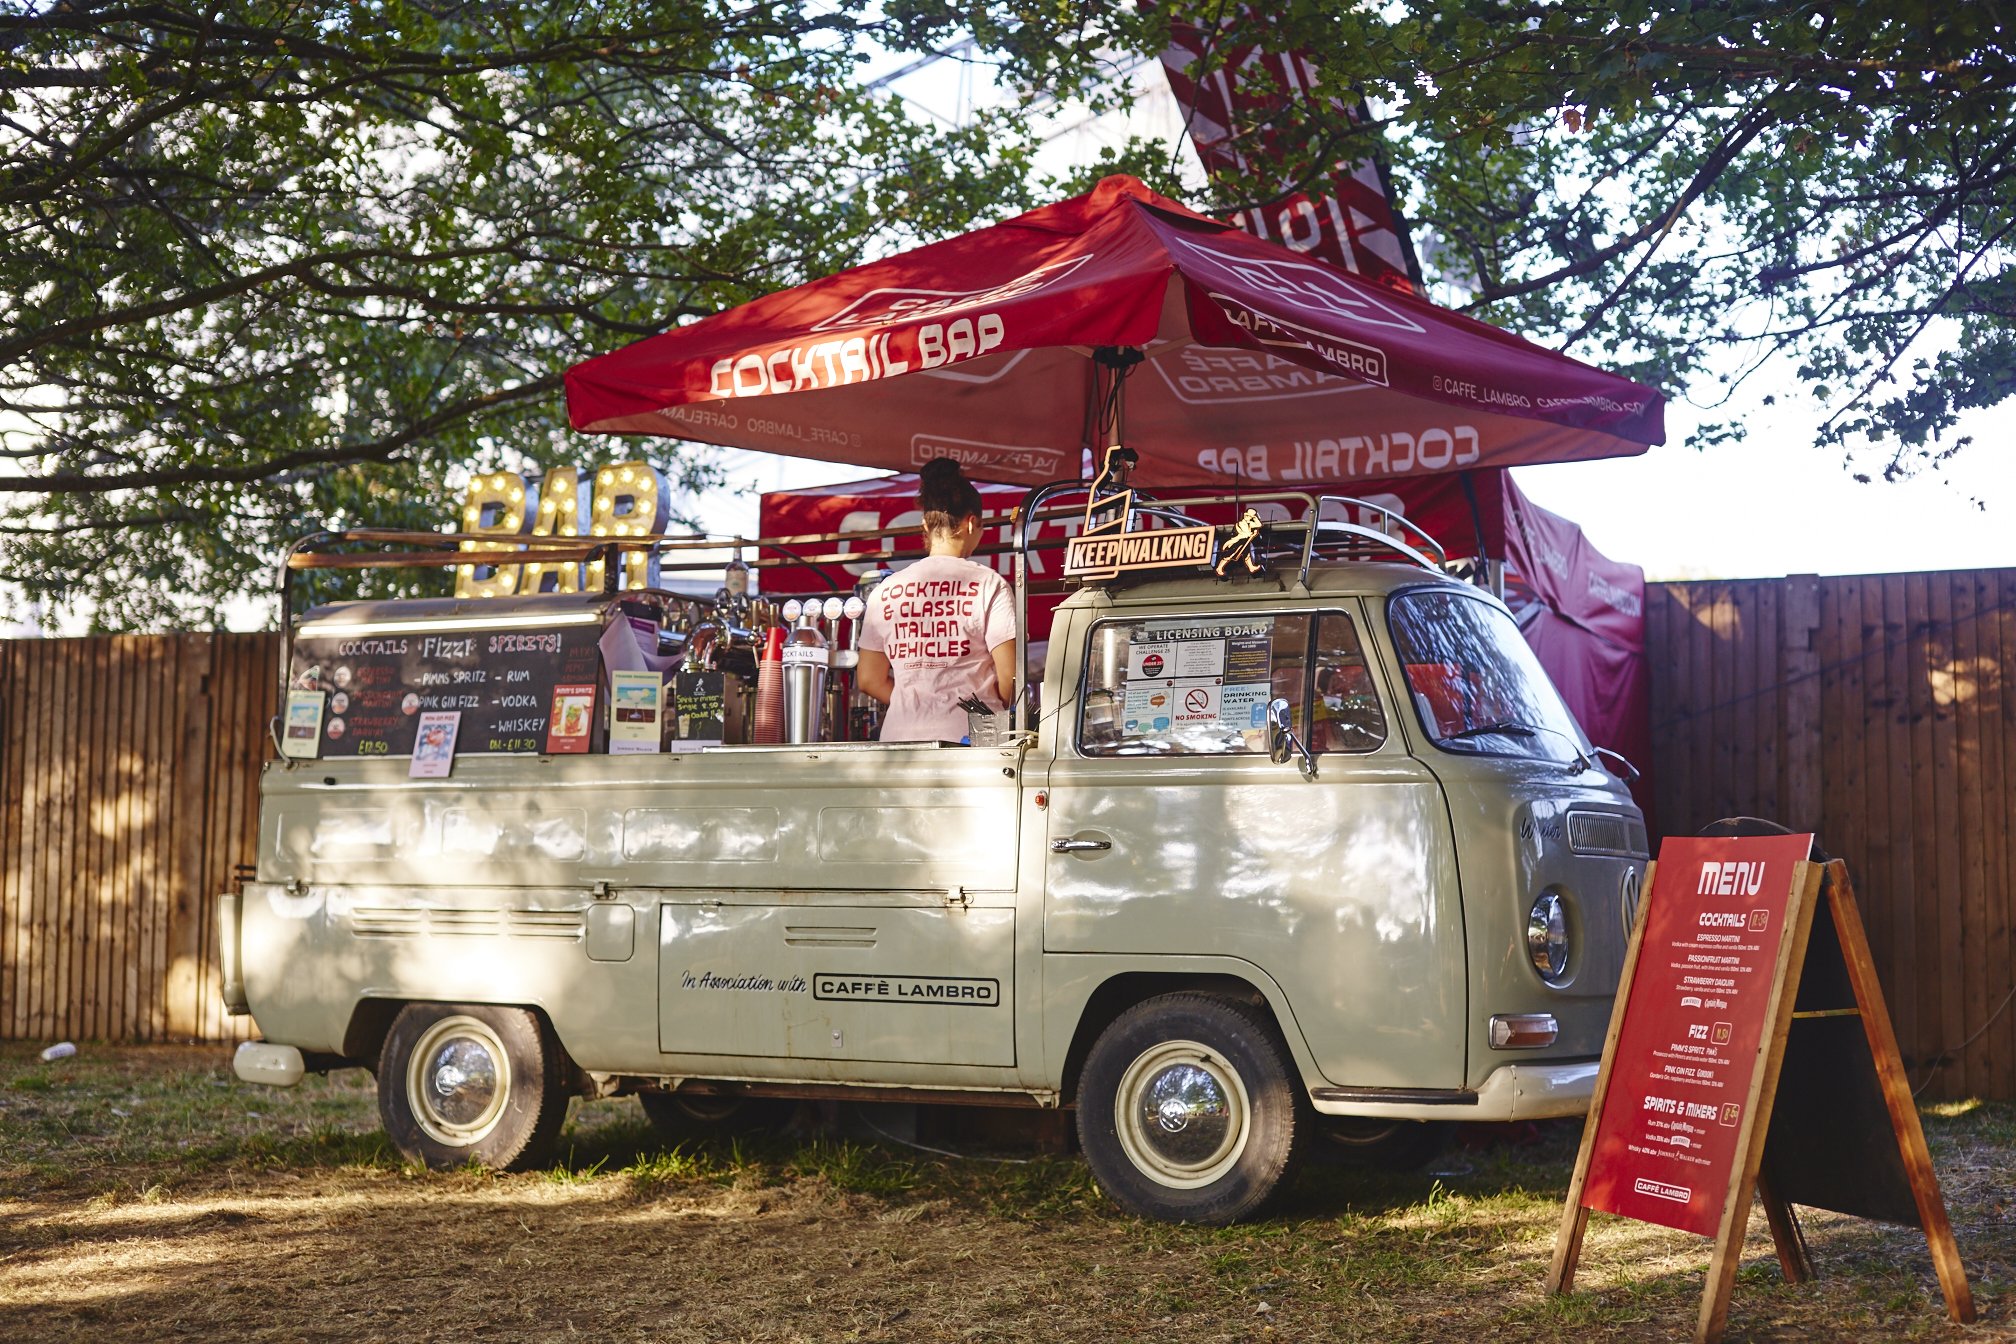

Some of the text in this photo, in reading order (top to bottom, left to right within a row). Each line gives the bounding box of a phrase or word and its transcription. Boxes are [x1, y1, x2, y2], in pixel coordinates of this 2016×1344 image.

[709, 313, 1005, 398] COCKTAIL BAR
[1444, 378, 1532, 409] CAFFE_LAMBRO
[454, 460, 662, 599] BAR
[1072, 533, 1208, 568] KEEP WALKING
[881, 580, 980, 602] COCKTAILS
[883, 600, 973, 621] & CLASSIC
[895, 620, 959, 639] ITALIAN
[1156, 627, 1220, 641] LICENSING
[1224, 625, 1268, 637] BOARD
[339, 639, 408, 656] COCKTAILS
[888, 639, 971, 660] VEHICLES
[453, 671, 486, 684] SPRITZ
[507, 670, 530, 682] RUM
[419, 694, 479, 708] PINK GIN FIZZ
[501, 695, 538, 708] VODKA
[498, 718, 546, 732] WHISKEY
[1697, 861, 1766, 896] MENU
[1698, 912, 1747, 927] COCKTAILS
[1696, 934, 1740, 943] ESPRESSO MARTINI
[1688, 954, 1740, 964] PASSIONFRUIT MARTINI
[682, 970, 807, 992] In Association with
[821, 980, 992, 999] CAFFÈ LAMBRO
[1684, 976, 1735, 987] STRAWBERRY DAIQUIRI
[1688, 1024, 1709, 1040] FIZZ
[1688, 1045, 1705, 1054] SPRITZ
[1664, 1064, 1676, 1074] PINK
[1676, 1066, 1685, 1075] GIN
[1685, 1068, 1696, 1076] FIZZ
[1644, 1096, 1677, 1114] SPIRITS
[1677, 1101, 1685, 1115] &
[1685, 1102, 1718, 1120] MIXERS
[1638, 1182, 1689, 1200] CAFFÈ LAMBRO
